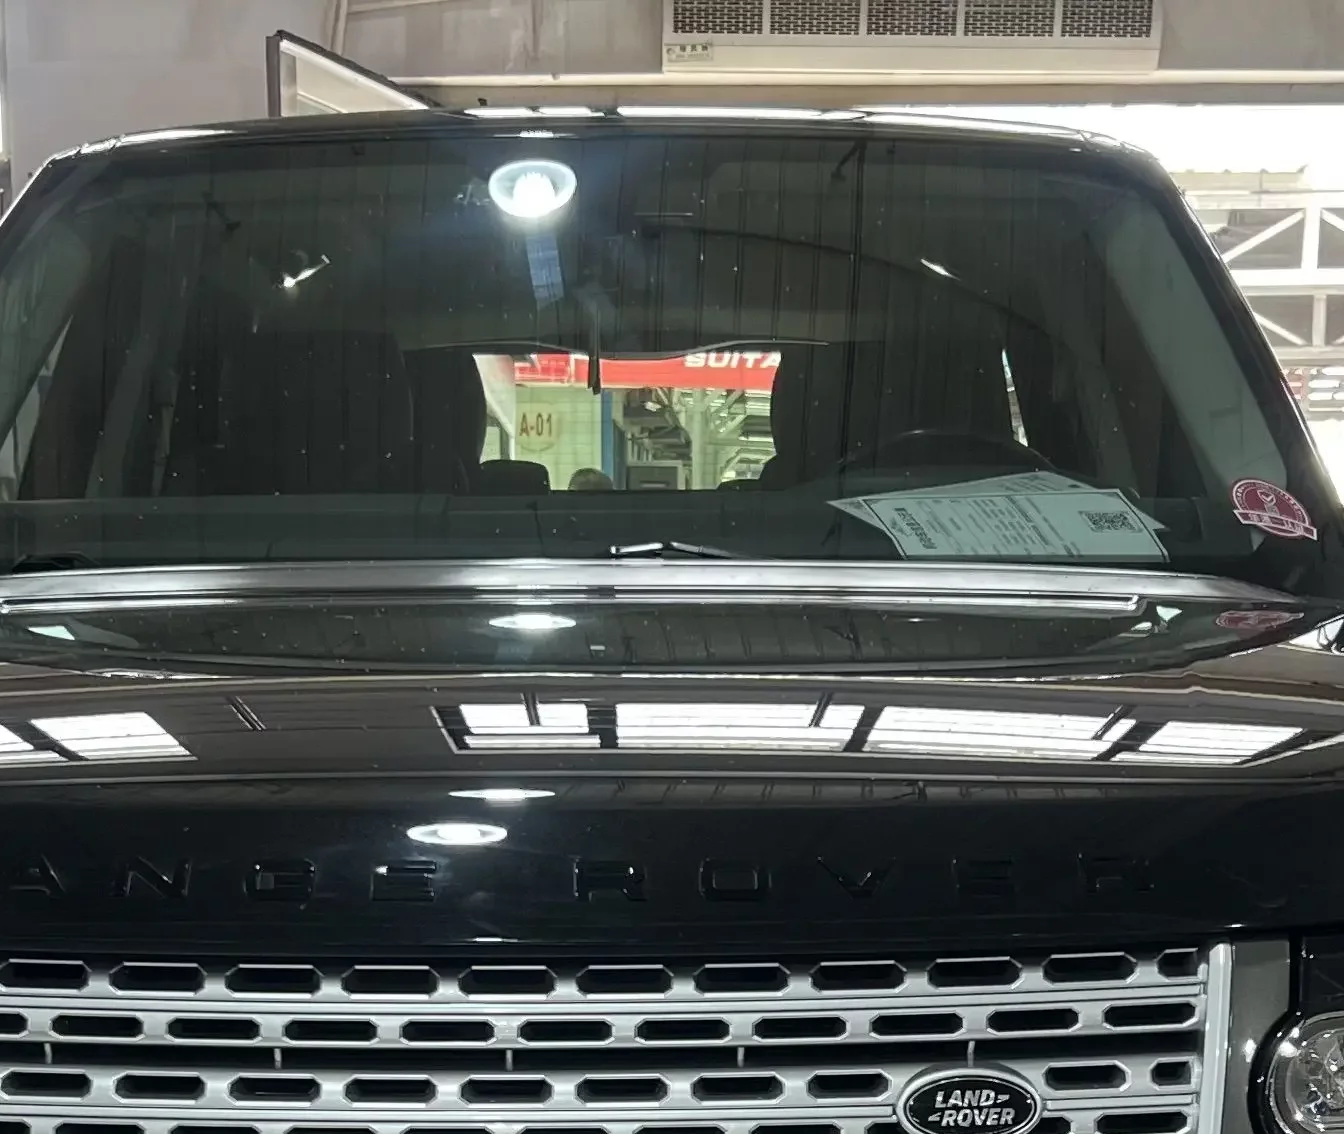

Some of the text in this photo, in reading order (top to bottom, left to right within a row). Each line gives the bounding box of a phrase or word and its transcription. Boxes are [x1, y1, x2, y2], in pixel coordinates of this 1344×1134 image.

[519, 411, 553, 437] A-01
[573, 851, 1155, 900] ROVER
[934, 1089, 997, 1109] LAND
[939, 1107, 1016, 1128] ROVER
